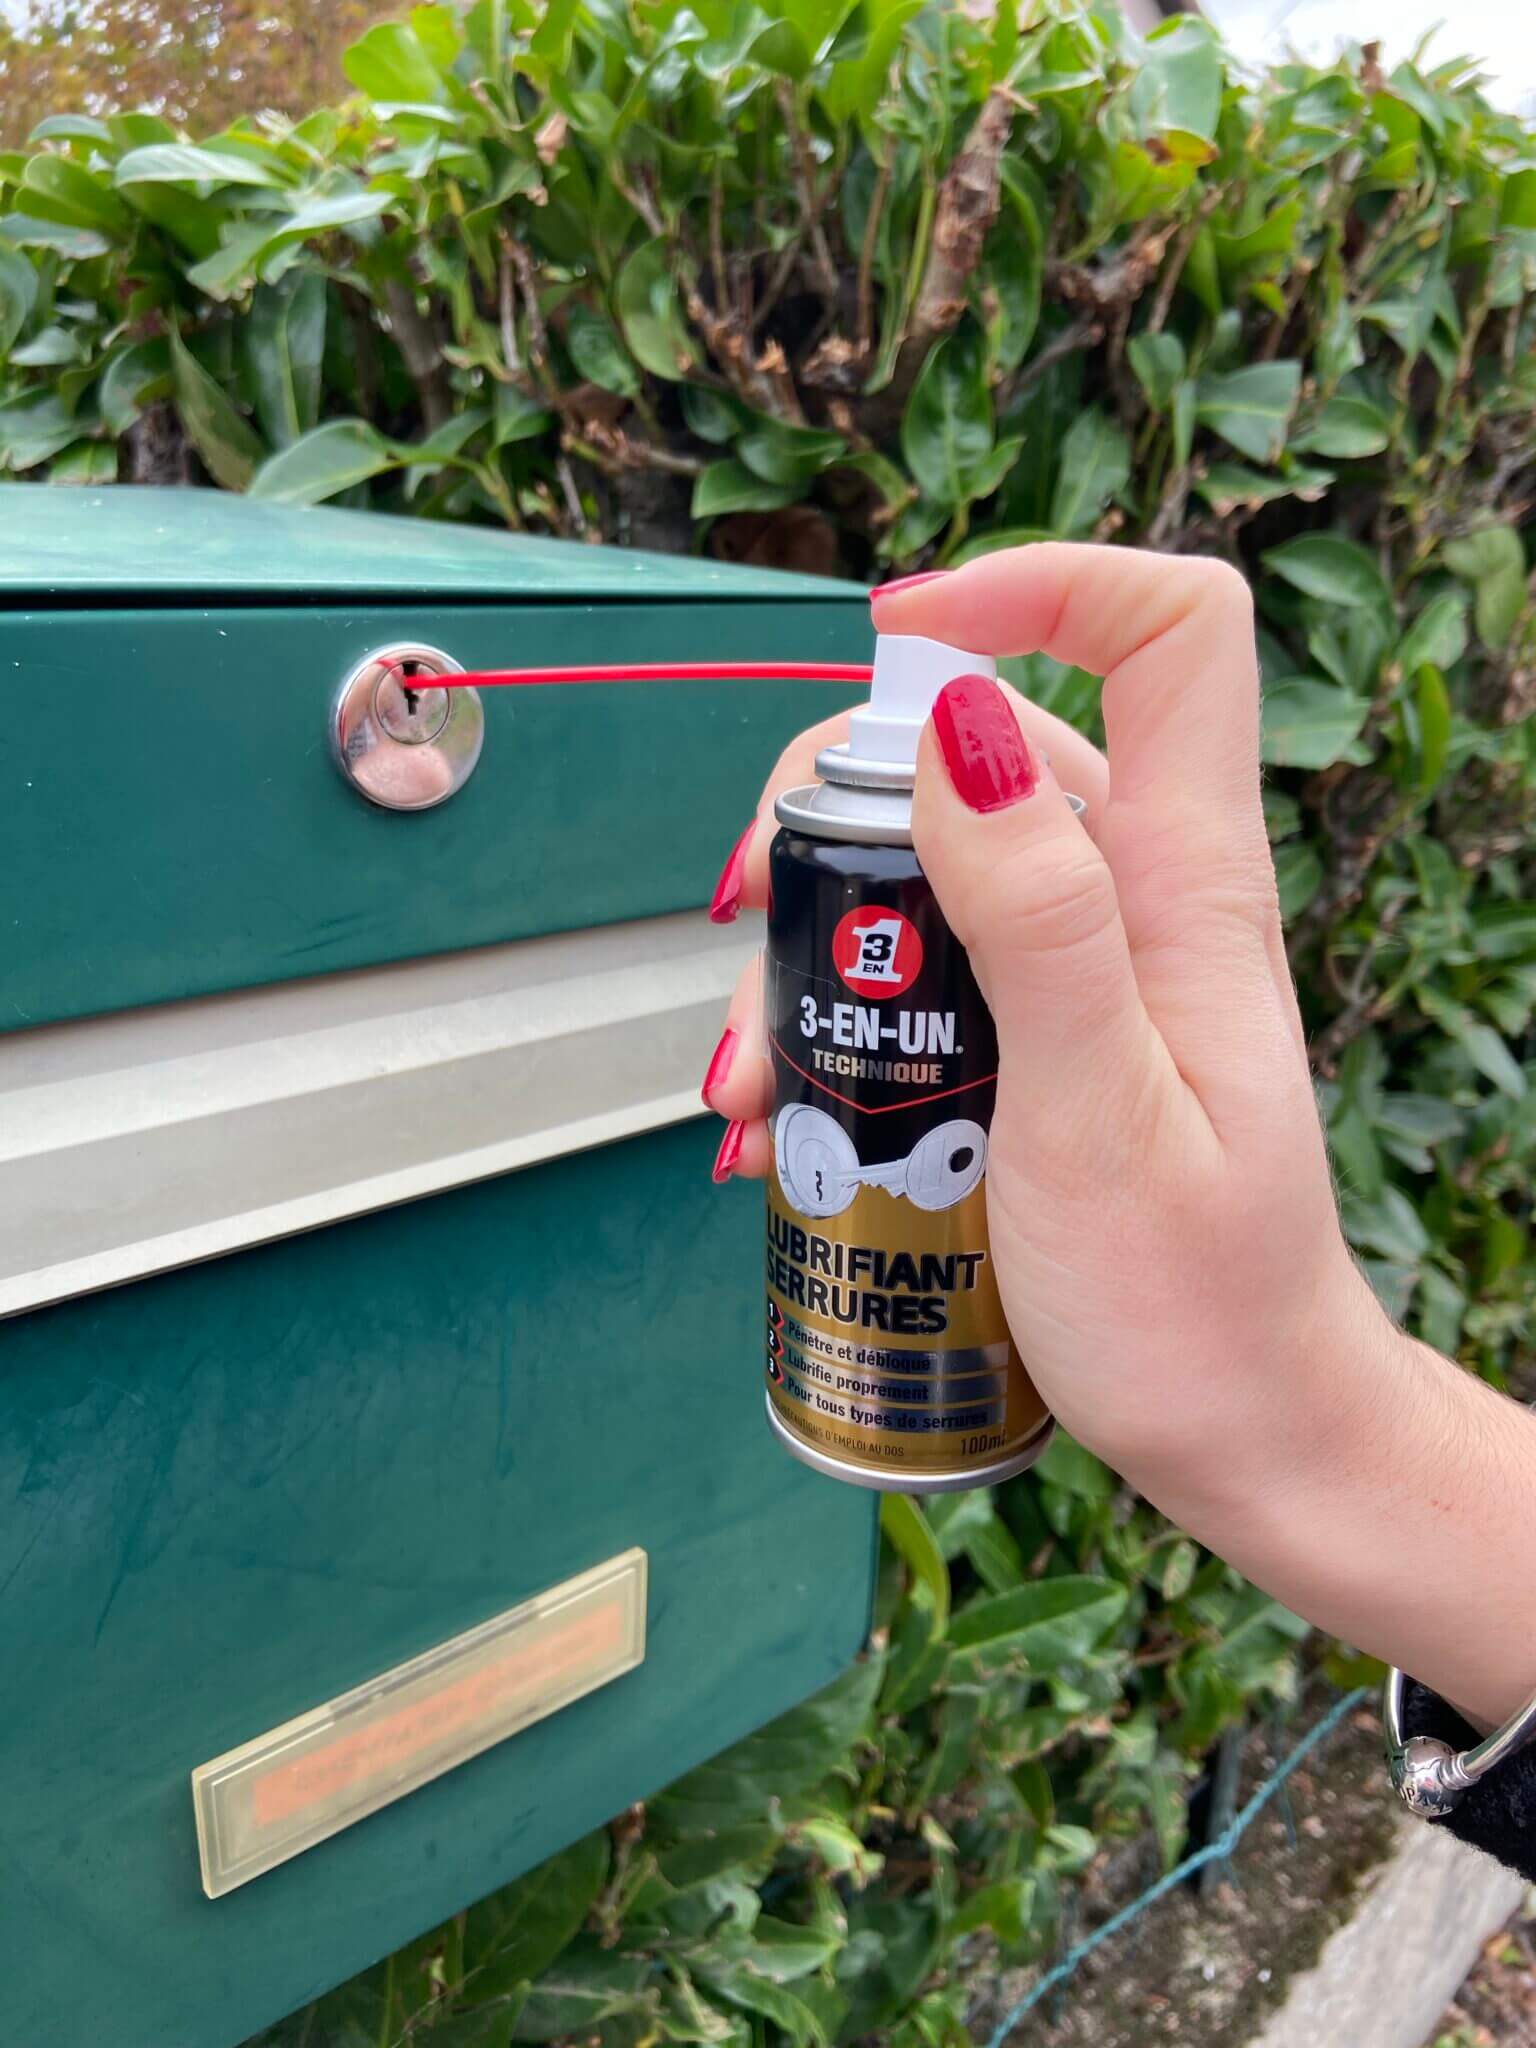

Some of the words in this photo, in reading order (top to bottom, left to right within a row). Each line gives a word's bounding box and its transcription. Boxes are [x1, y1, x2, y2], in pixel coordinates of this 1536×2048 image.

[862, 933, 893, 961] 3
[862, 963, 885, 974] EN
[812, 1048, 944, 1085] TECHNIQUE
[767, 1203, 985, 1293] LUBRIFIANT
[767, 1244, 948, 1335] SERRURES
[788, 1320, 833, 1354] Pénètre
[837, 1346, 853, 1361] et
[856, 1349, 931, 1373] débloque
[788, 1349, 832, 1383] Lubrifie
[836, 1374, 929, 1401] proprement
[788, 1377, 813, 1403] Pour
[816, 1395, 846, 1417] tous
[850, 1405, 893, 1426] types
[897, 1413, 918, 1429] de
[922, 1412, 988, 1430] serrures
